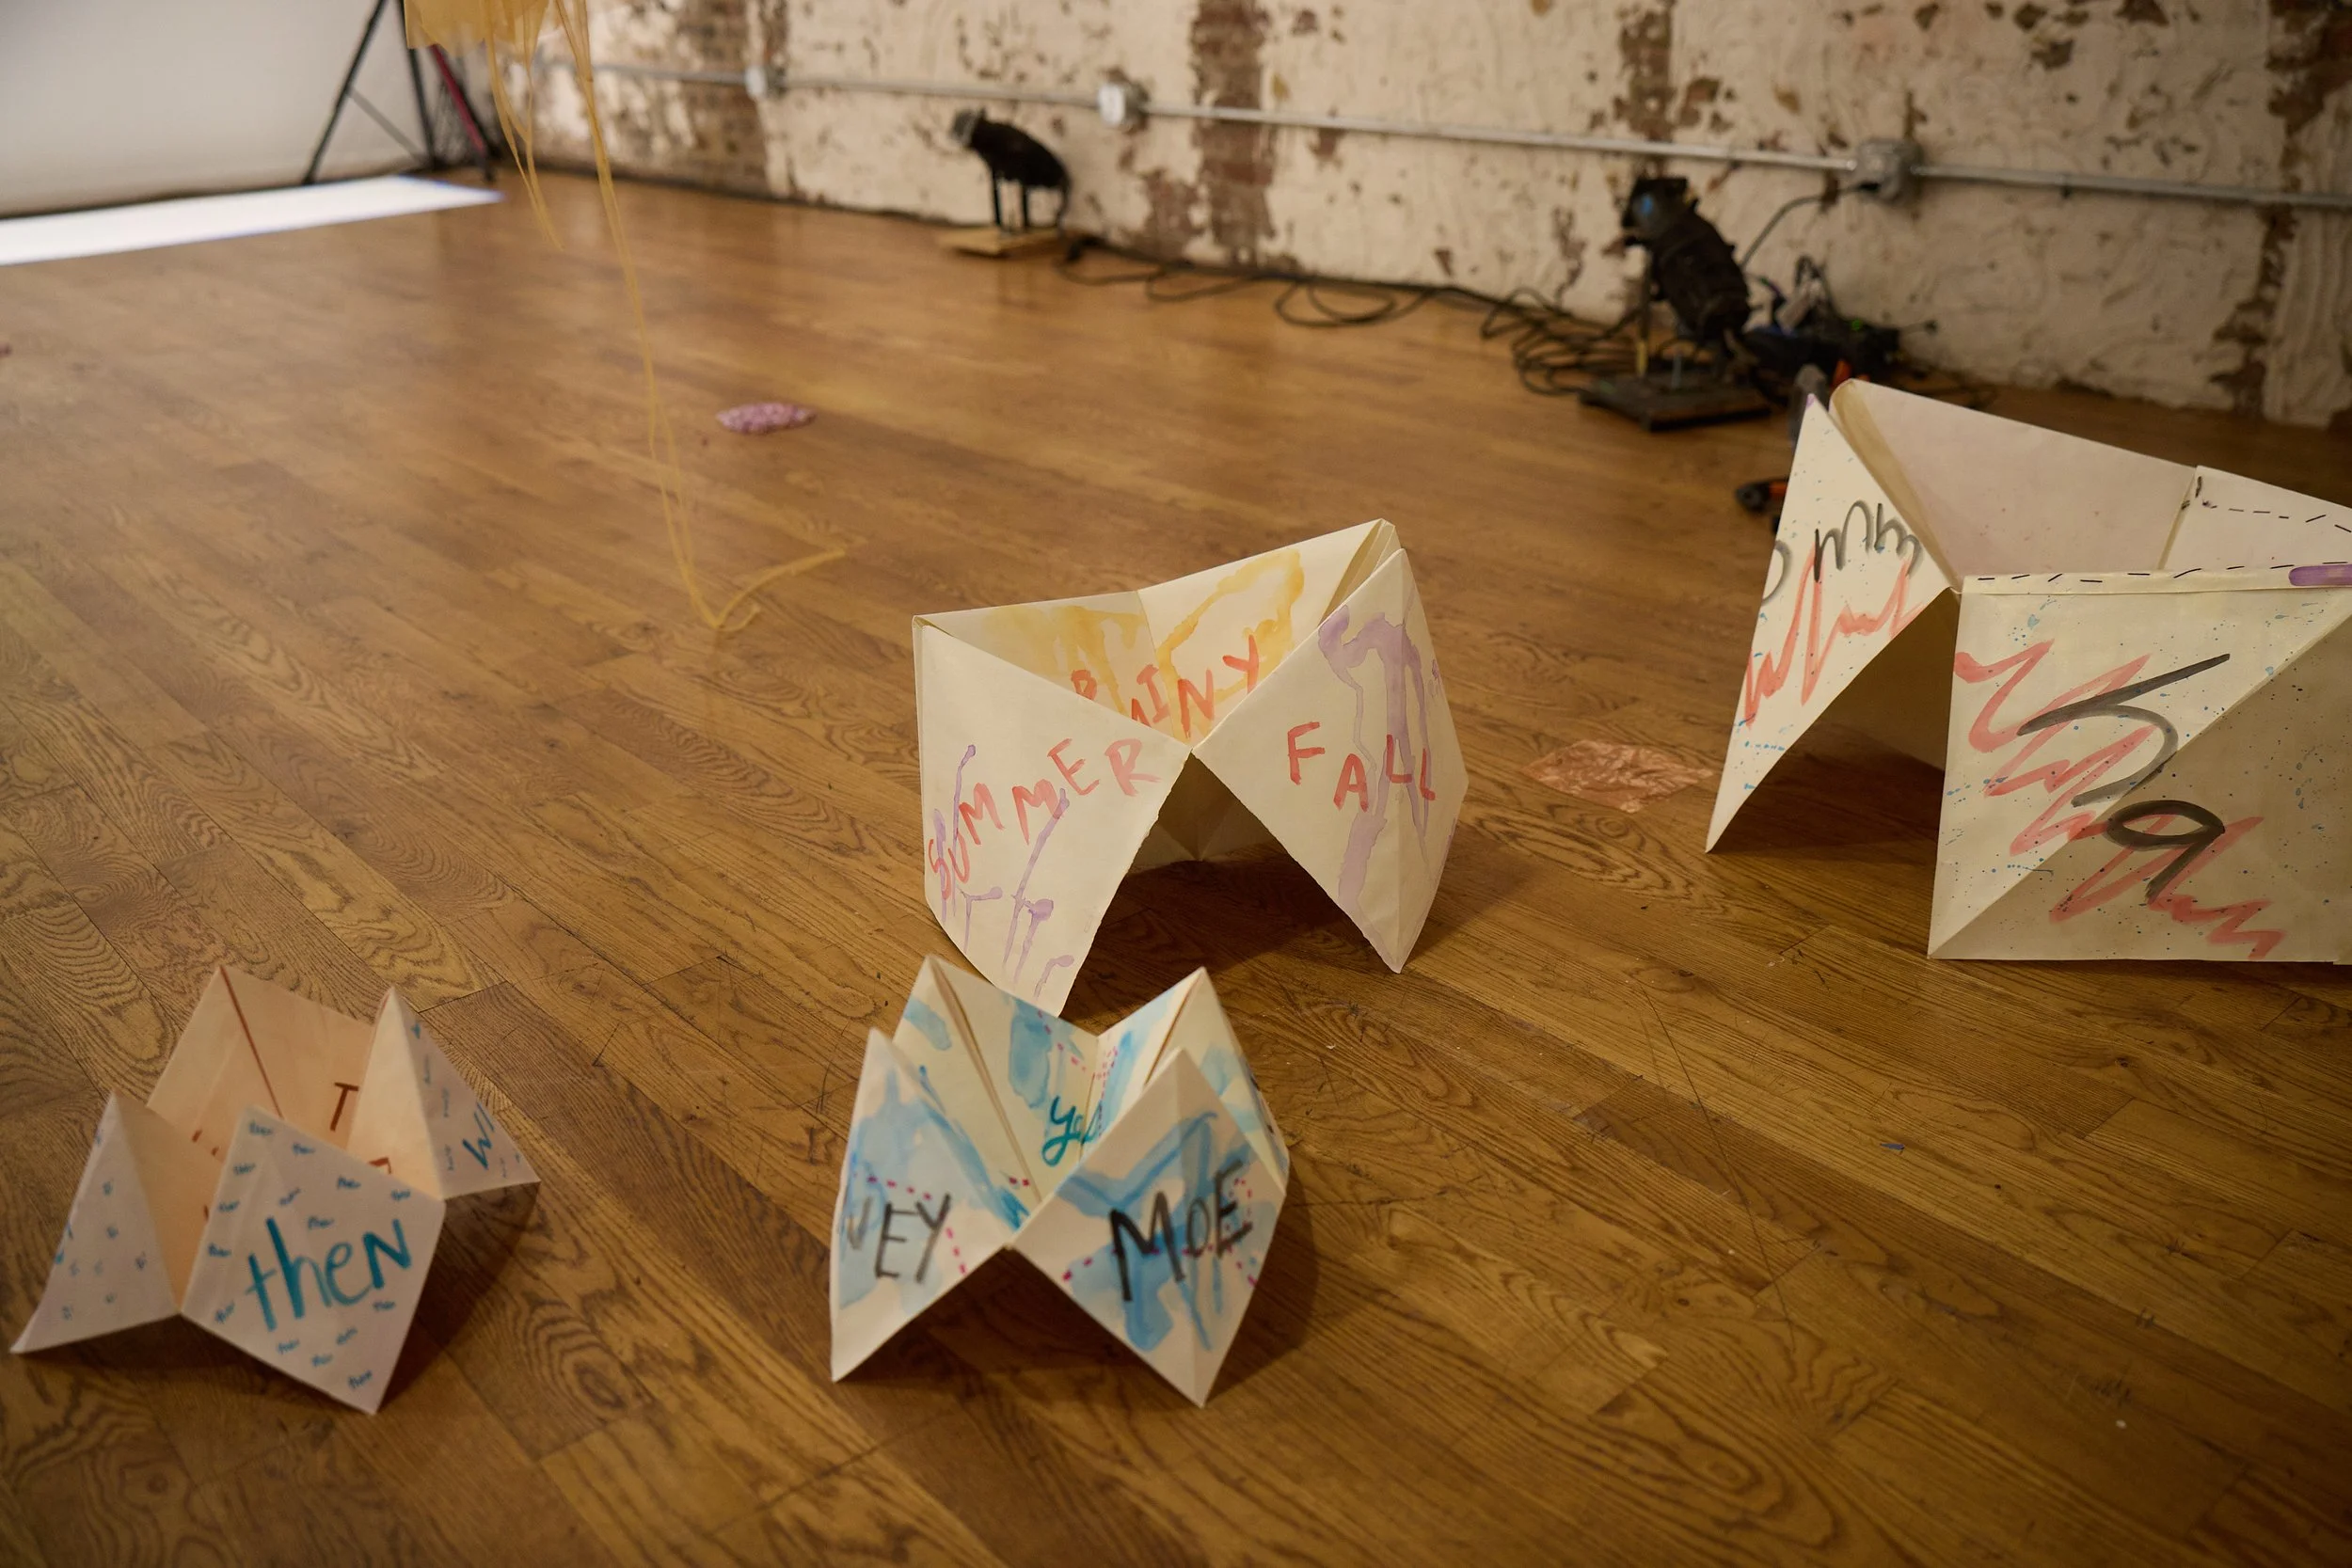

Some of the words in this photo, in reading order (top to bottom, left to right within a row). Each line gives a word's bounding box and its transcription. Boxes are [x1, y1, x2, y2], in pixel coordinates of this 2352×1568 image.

[928, 737, 1162, 900] SUMMER
[1287, 721, 1437, 813] FALL
[1110, 1158, 1254, 1302] MOE
